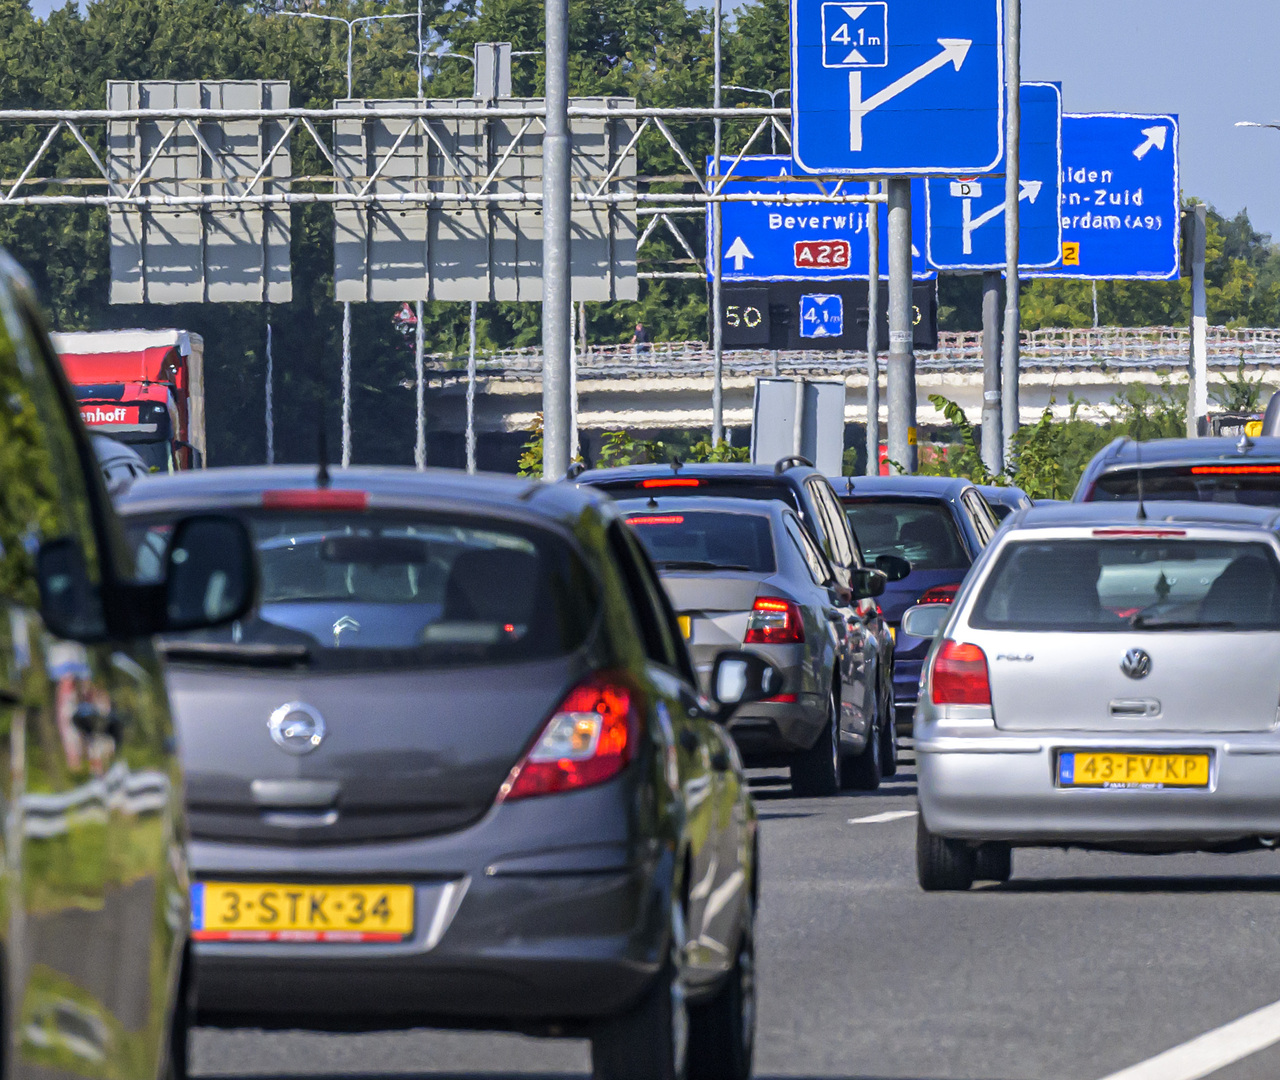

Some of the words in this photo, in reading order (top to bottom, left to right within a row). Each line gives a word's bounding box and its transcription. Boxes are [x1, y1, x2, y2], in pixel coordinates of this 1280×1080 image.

[1061, 167, 1113, 184] iden
[960, 183, 971, 196] D
[798, 245, 846, 264] A22
[725, 305, 762, 328] 50
[1083, 756, 1197, 780] 43-FV-KP
[221, 891, 391, 925] 3-STK-34
